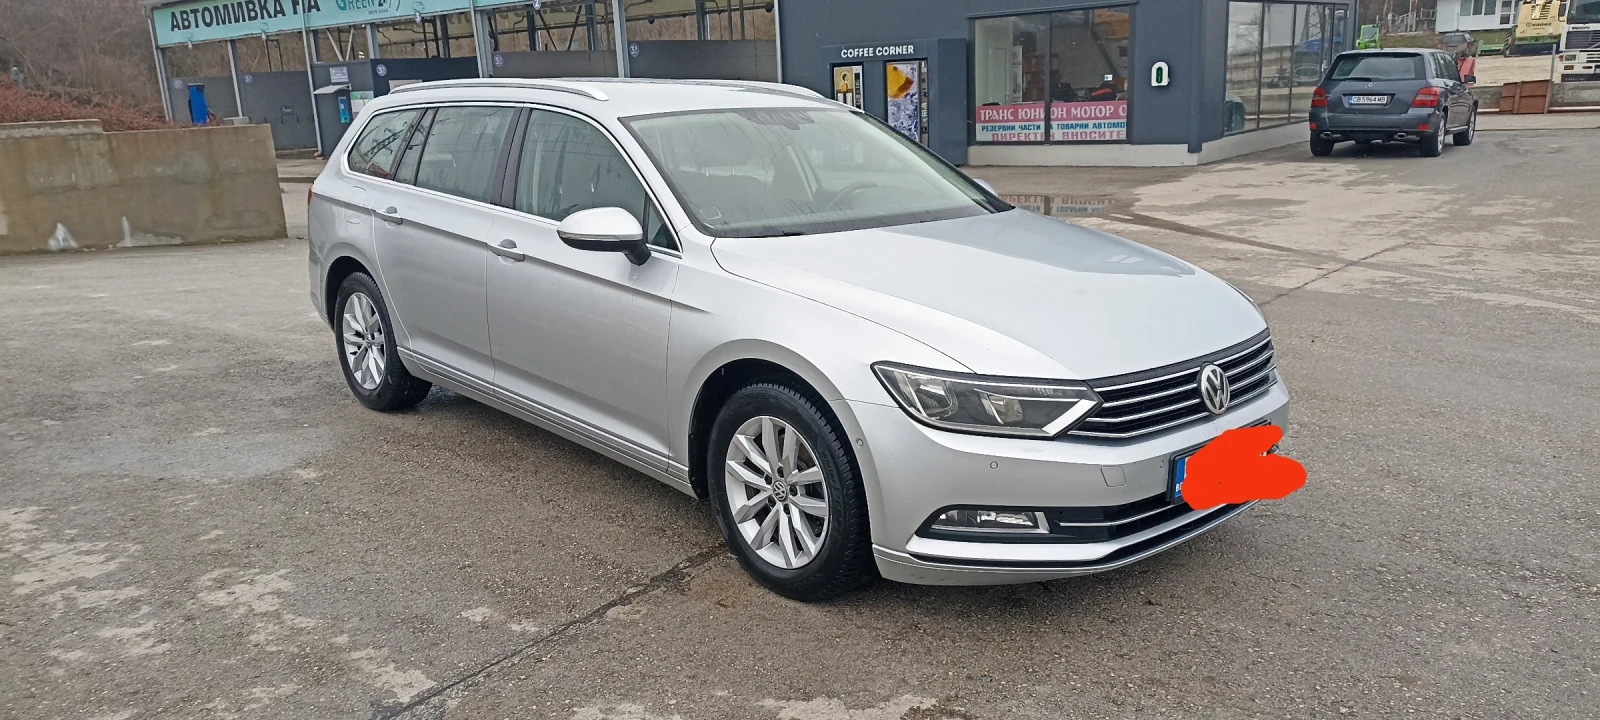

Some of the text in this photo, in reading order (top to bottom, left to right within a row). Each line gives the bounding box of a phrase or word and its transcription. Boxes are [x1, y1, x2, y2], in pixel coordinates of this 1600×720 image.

[171, 0, 286, 31] АВТОМИВКА
[841, 45, 914, 58] COFFEE CORNER
[980, 108, 1014, 121] ТРАНС
[1071, 105, 1114, 119] МОТОР
[1057, 122, 1089, 130] ТОВАРНИ
[1092, 121, 1126, 129] АВТОМО
[1062, 130, 1124, 140] ВНОСИТЕ
